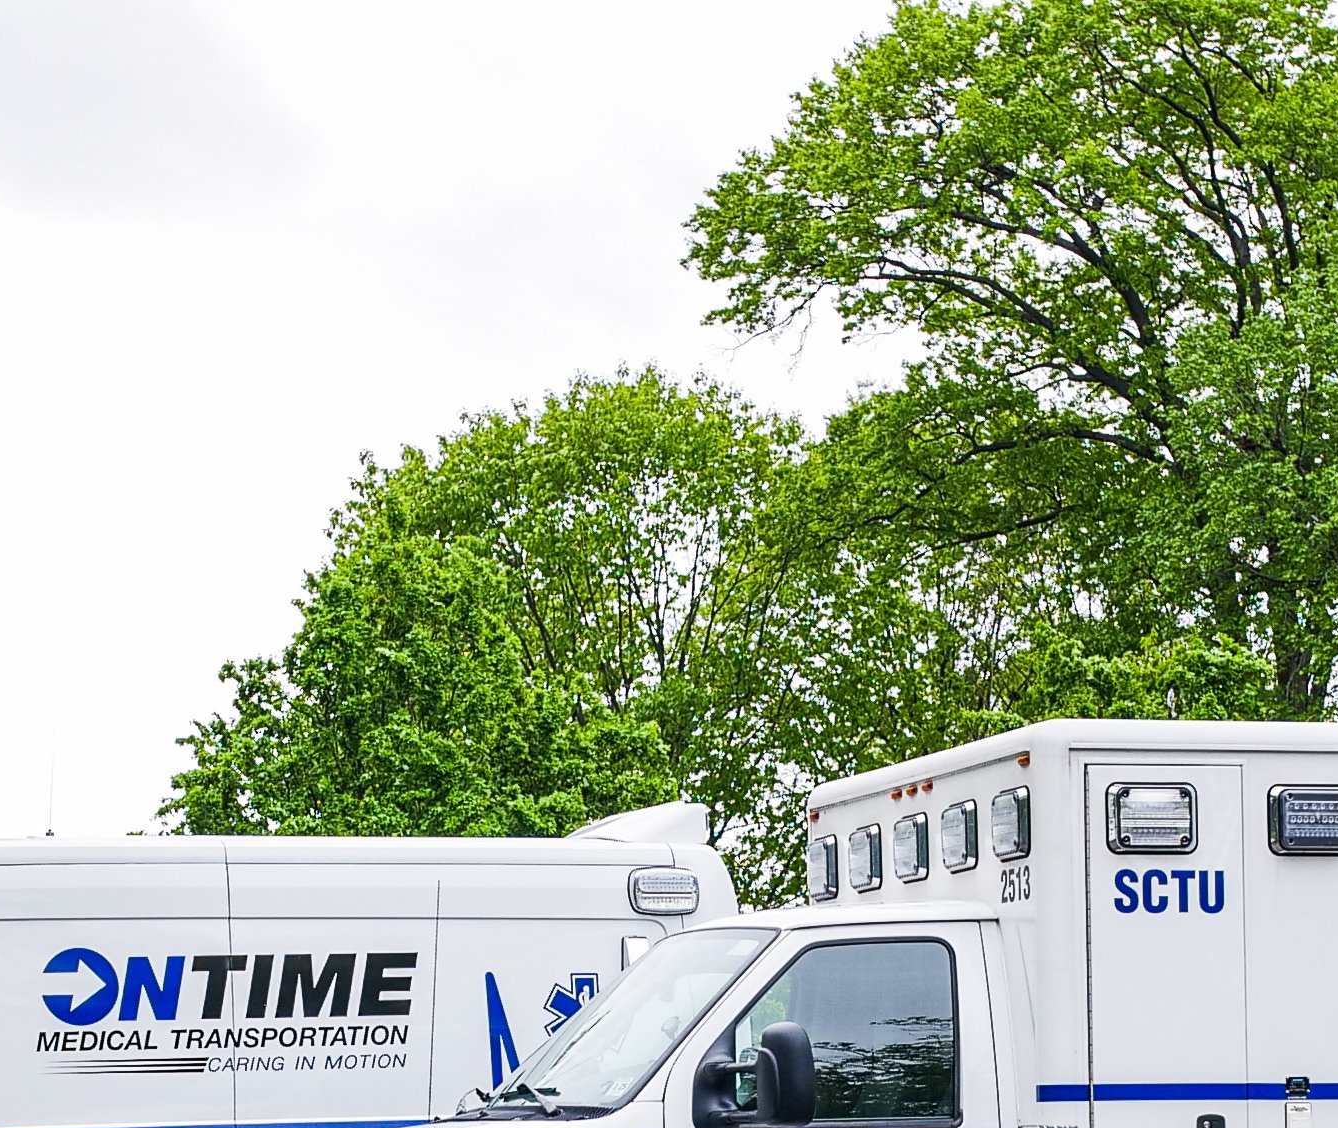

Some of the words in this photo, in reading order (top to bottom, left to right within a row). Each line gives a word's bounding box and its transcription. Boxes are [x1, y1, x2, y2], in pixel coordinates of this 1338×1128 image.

[1001, 865, 1031, 904] 2513
[1113, 868, 1225, 914] SCTU
[36, 1030, 158, 1053] MEDICAL
[170, 1025, 409, 1050] TRANSPORTATION
[207, 1056, 285, 1073] CARING
[294, 1055, 316, 1071] IN
[324, 1053, 407, 1070] MOTION
